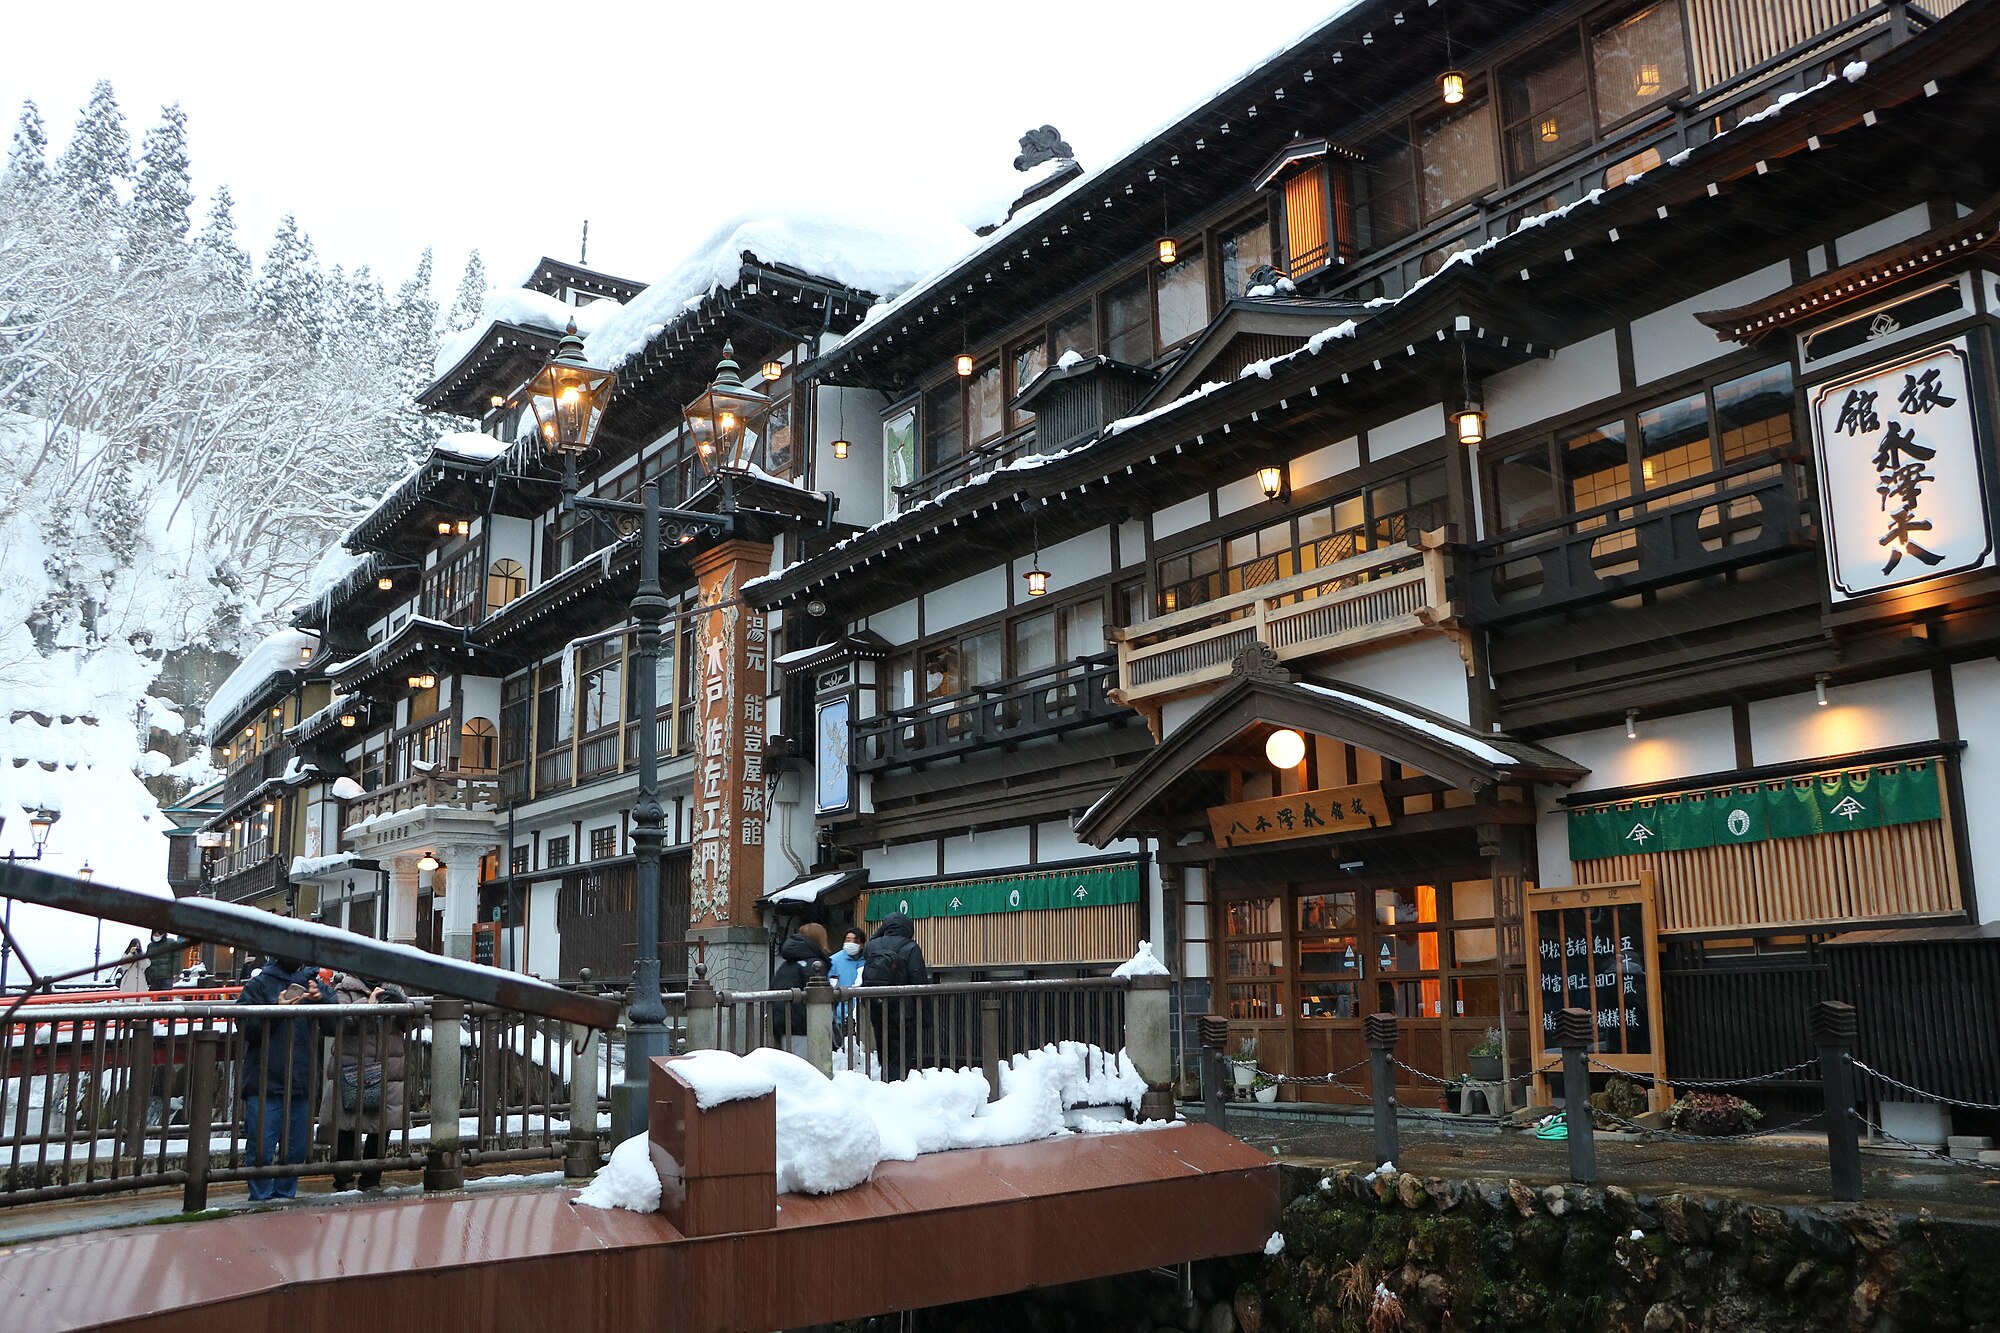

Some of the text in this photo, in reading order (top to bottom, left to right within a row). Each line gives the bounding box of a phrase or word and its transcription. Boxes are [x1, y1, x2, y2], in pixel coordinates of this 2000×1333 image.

[742, 615, 765, 846] 湯元 能登屋旅館
